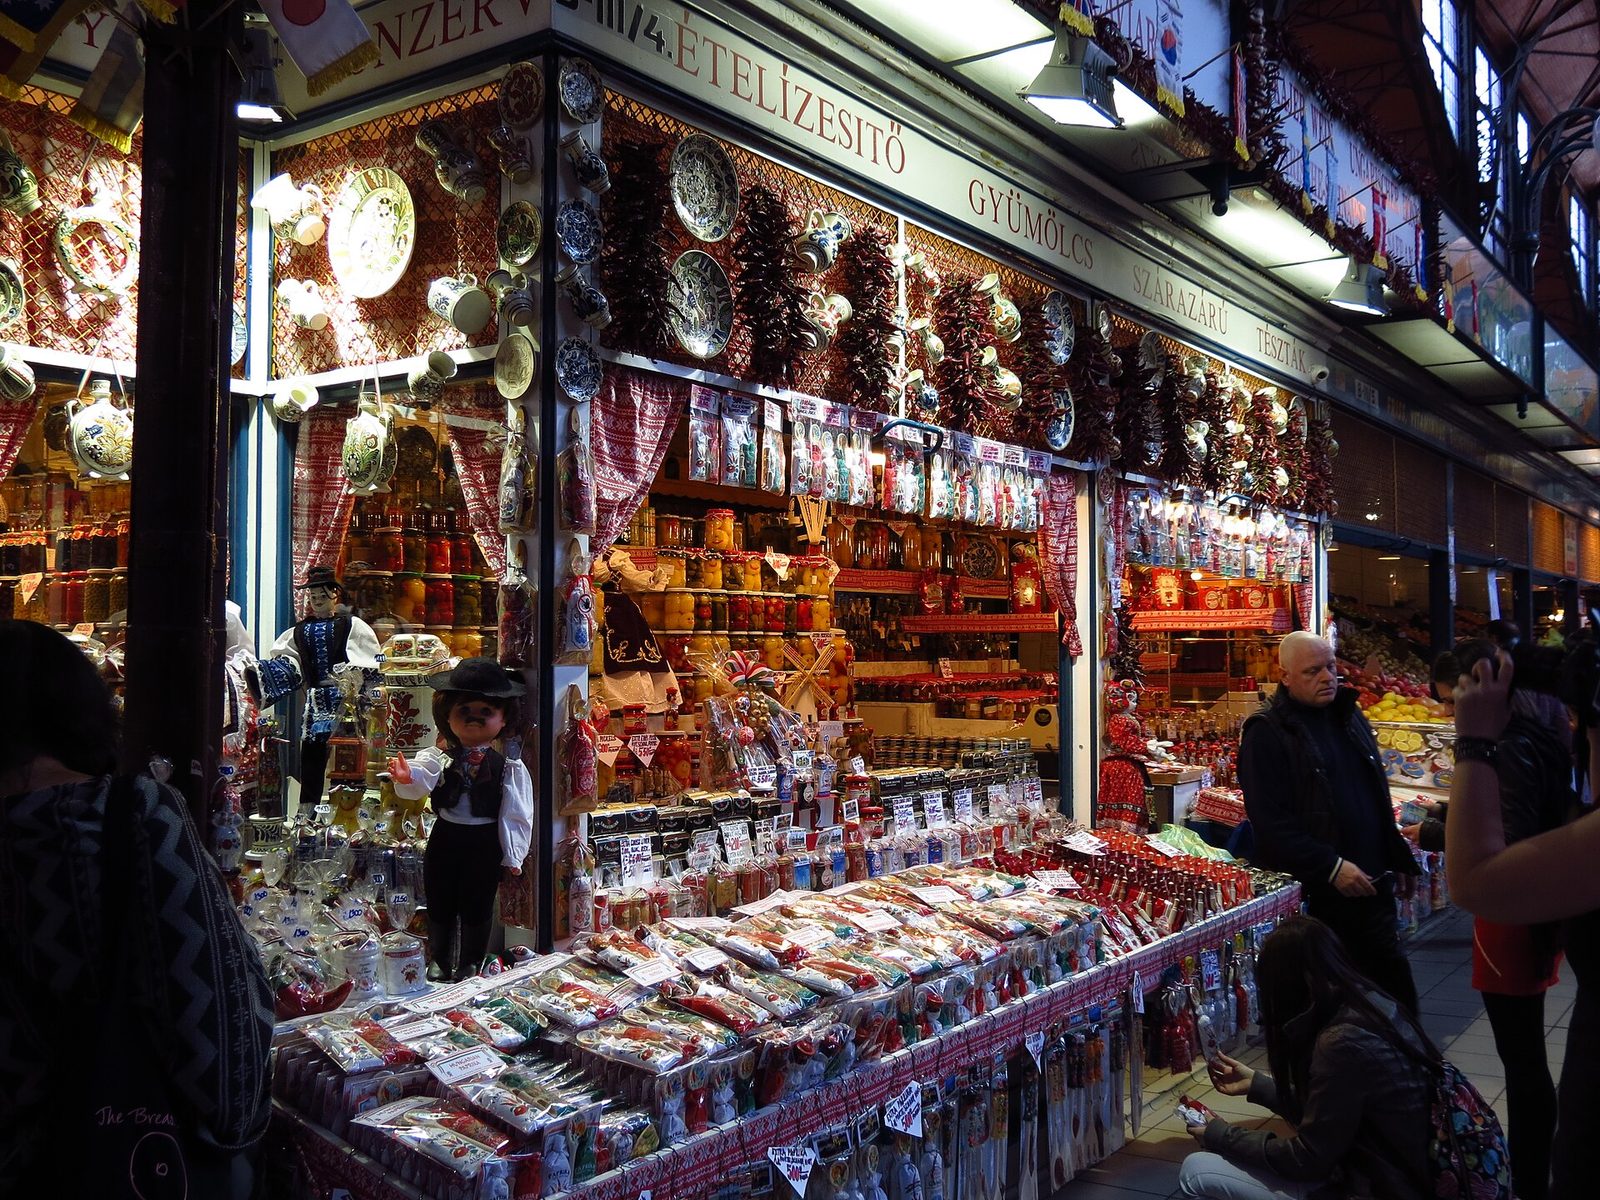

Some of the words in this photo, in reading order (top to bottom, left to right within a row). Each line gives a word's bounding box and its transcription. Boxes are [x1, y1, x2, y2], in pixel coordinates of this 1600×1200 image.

[967, 178, 1095, 270] GYÜMÖLCS
[1132, 265, 1229, 335] SZÁRAZÁRÚ
[1256, 324, 1308, 374] TÉSZTÁK
[95, 1105, 124, 1126] The
